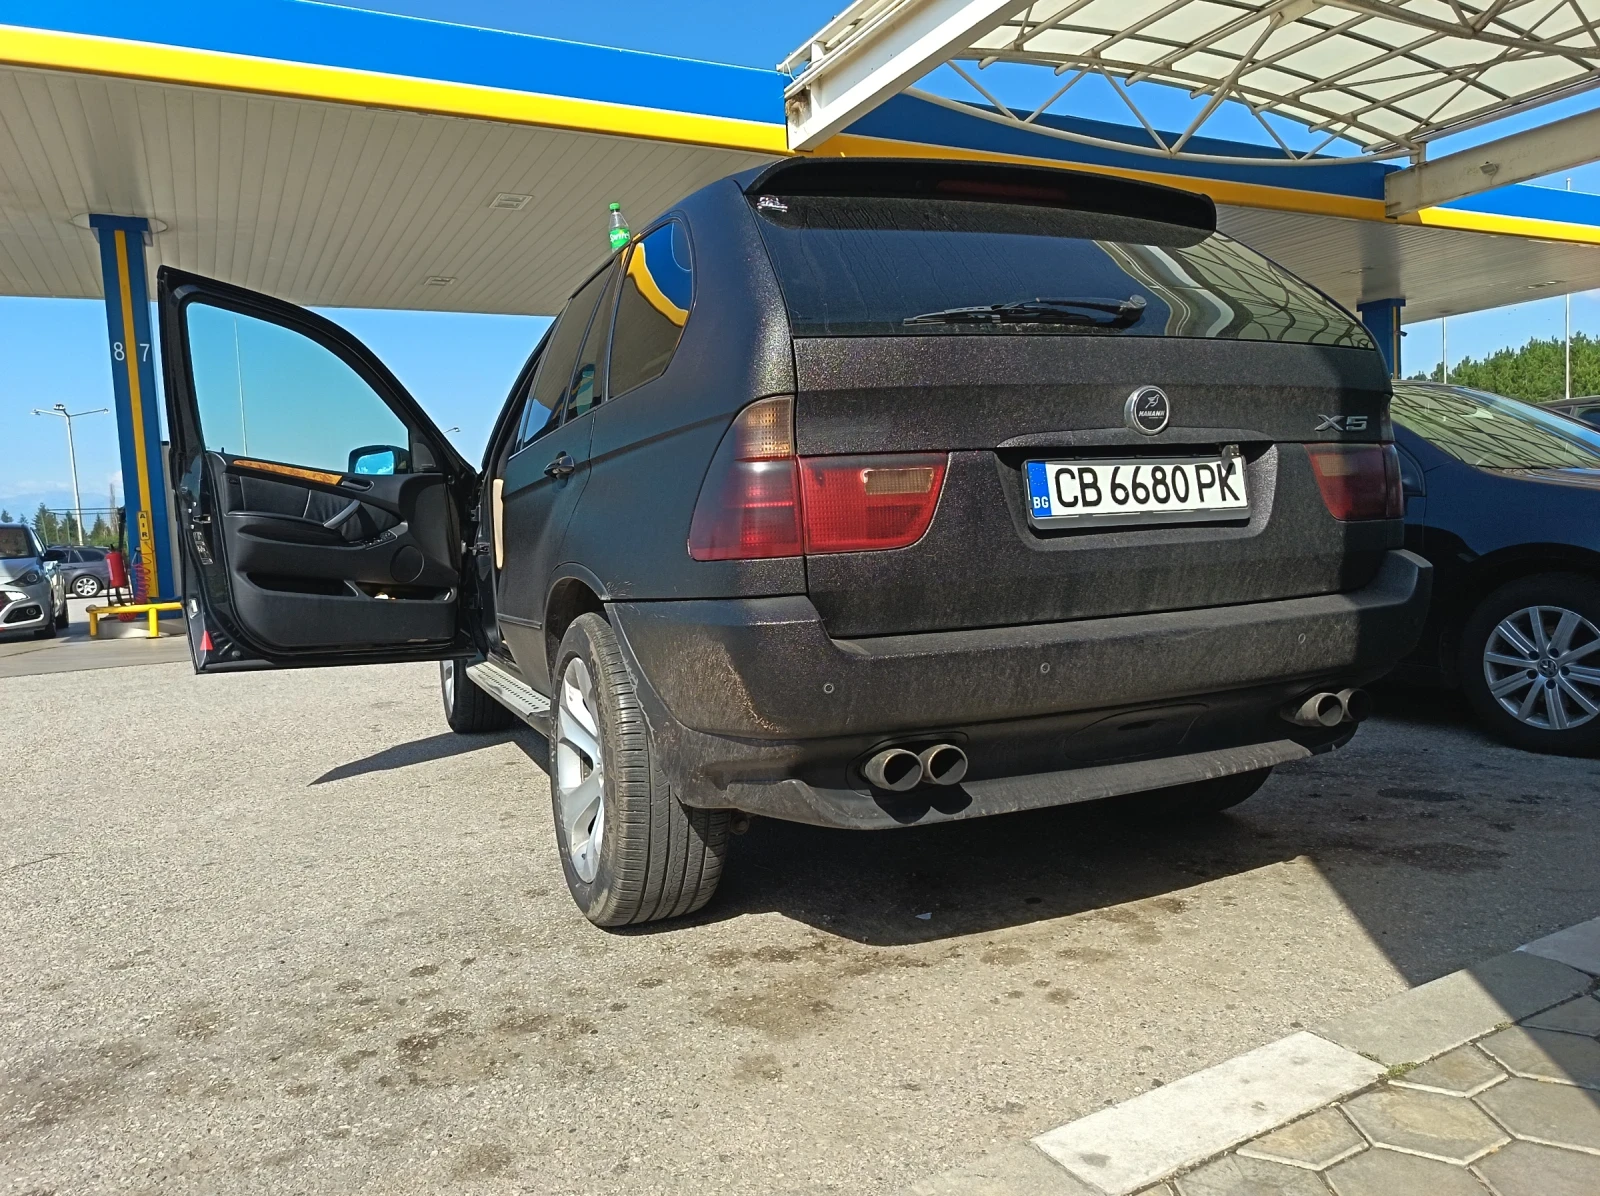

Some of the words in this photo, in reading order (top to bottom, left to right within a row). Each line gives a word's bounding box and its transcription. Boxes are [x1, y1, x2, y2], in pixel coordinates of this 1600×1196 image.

[113, 341, 126, 361] 8
[139, 343, 150, 362] 7
[1314, 414, 1368, 432] X5
[1054, 466, 1101, 508] CB
[1109, 464, 1191, 505] 6680
[1194, 463, 1241, 502] PK
[1033, 497, 1049, 510] BG
[139, 513, 148, 538] AIR
